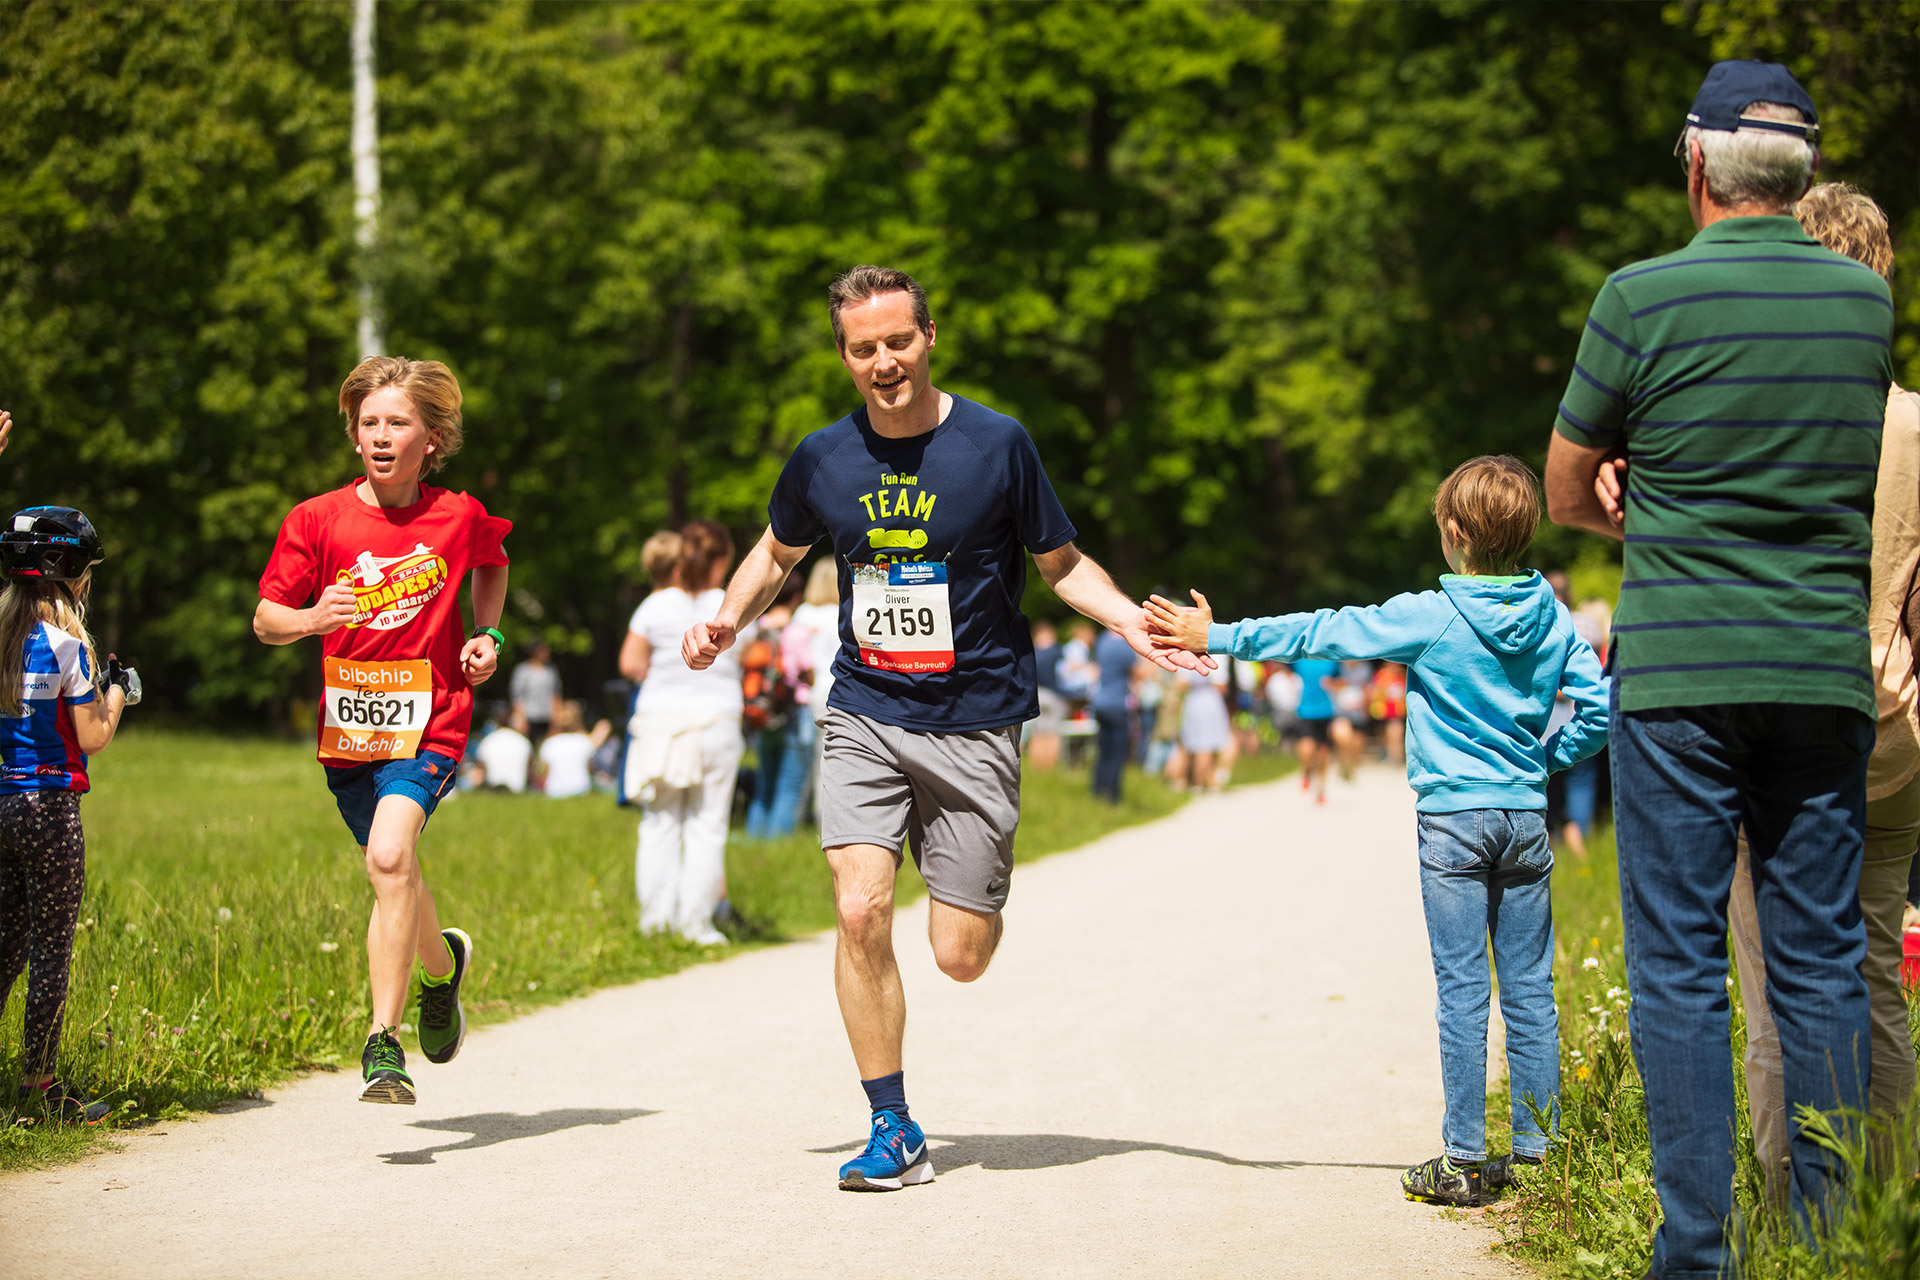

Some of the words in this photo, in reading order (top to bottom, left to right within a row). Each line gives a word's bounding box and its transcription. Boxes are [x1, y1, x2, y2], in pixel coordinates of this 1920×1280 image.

[881, 473, 898, 486] Fun
[900, 472, 918, 486] Run
[858, 488, 937, 522] TEAM
[398, 564, 427, 579] SPAR
[397, 577, 445, 609] maraton
[885, 594, 910, 604] Oliver
[380, 616, 391, 626] 10
[392, 612, 409, 622] km
[866, 607, 935, 636] 2159
[881, 660, 913, 669] Sparkasse
[914, 661, 947, 671] Bayreuth
[339, 666, 413, 686] bibchip
[353, 684, 386, 698] Teo
[337, 696, 415, 726] 65621
[337, 735, 405, 754] bibchip
